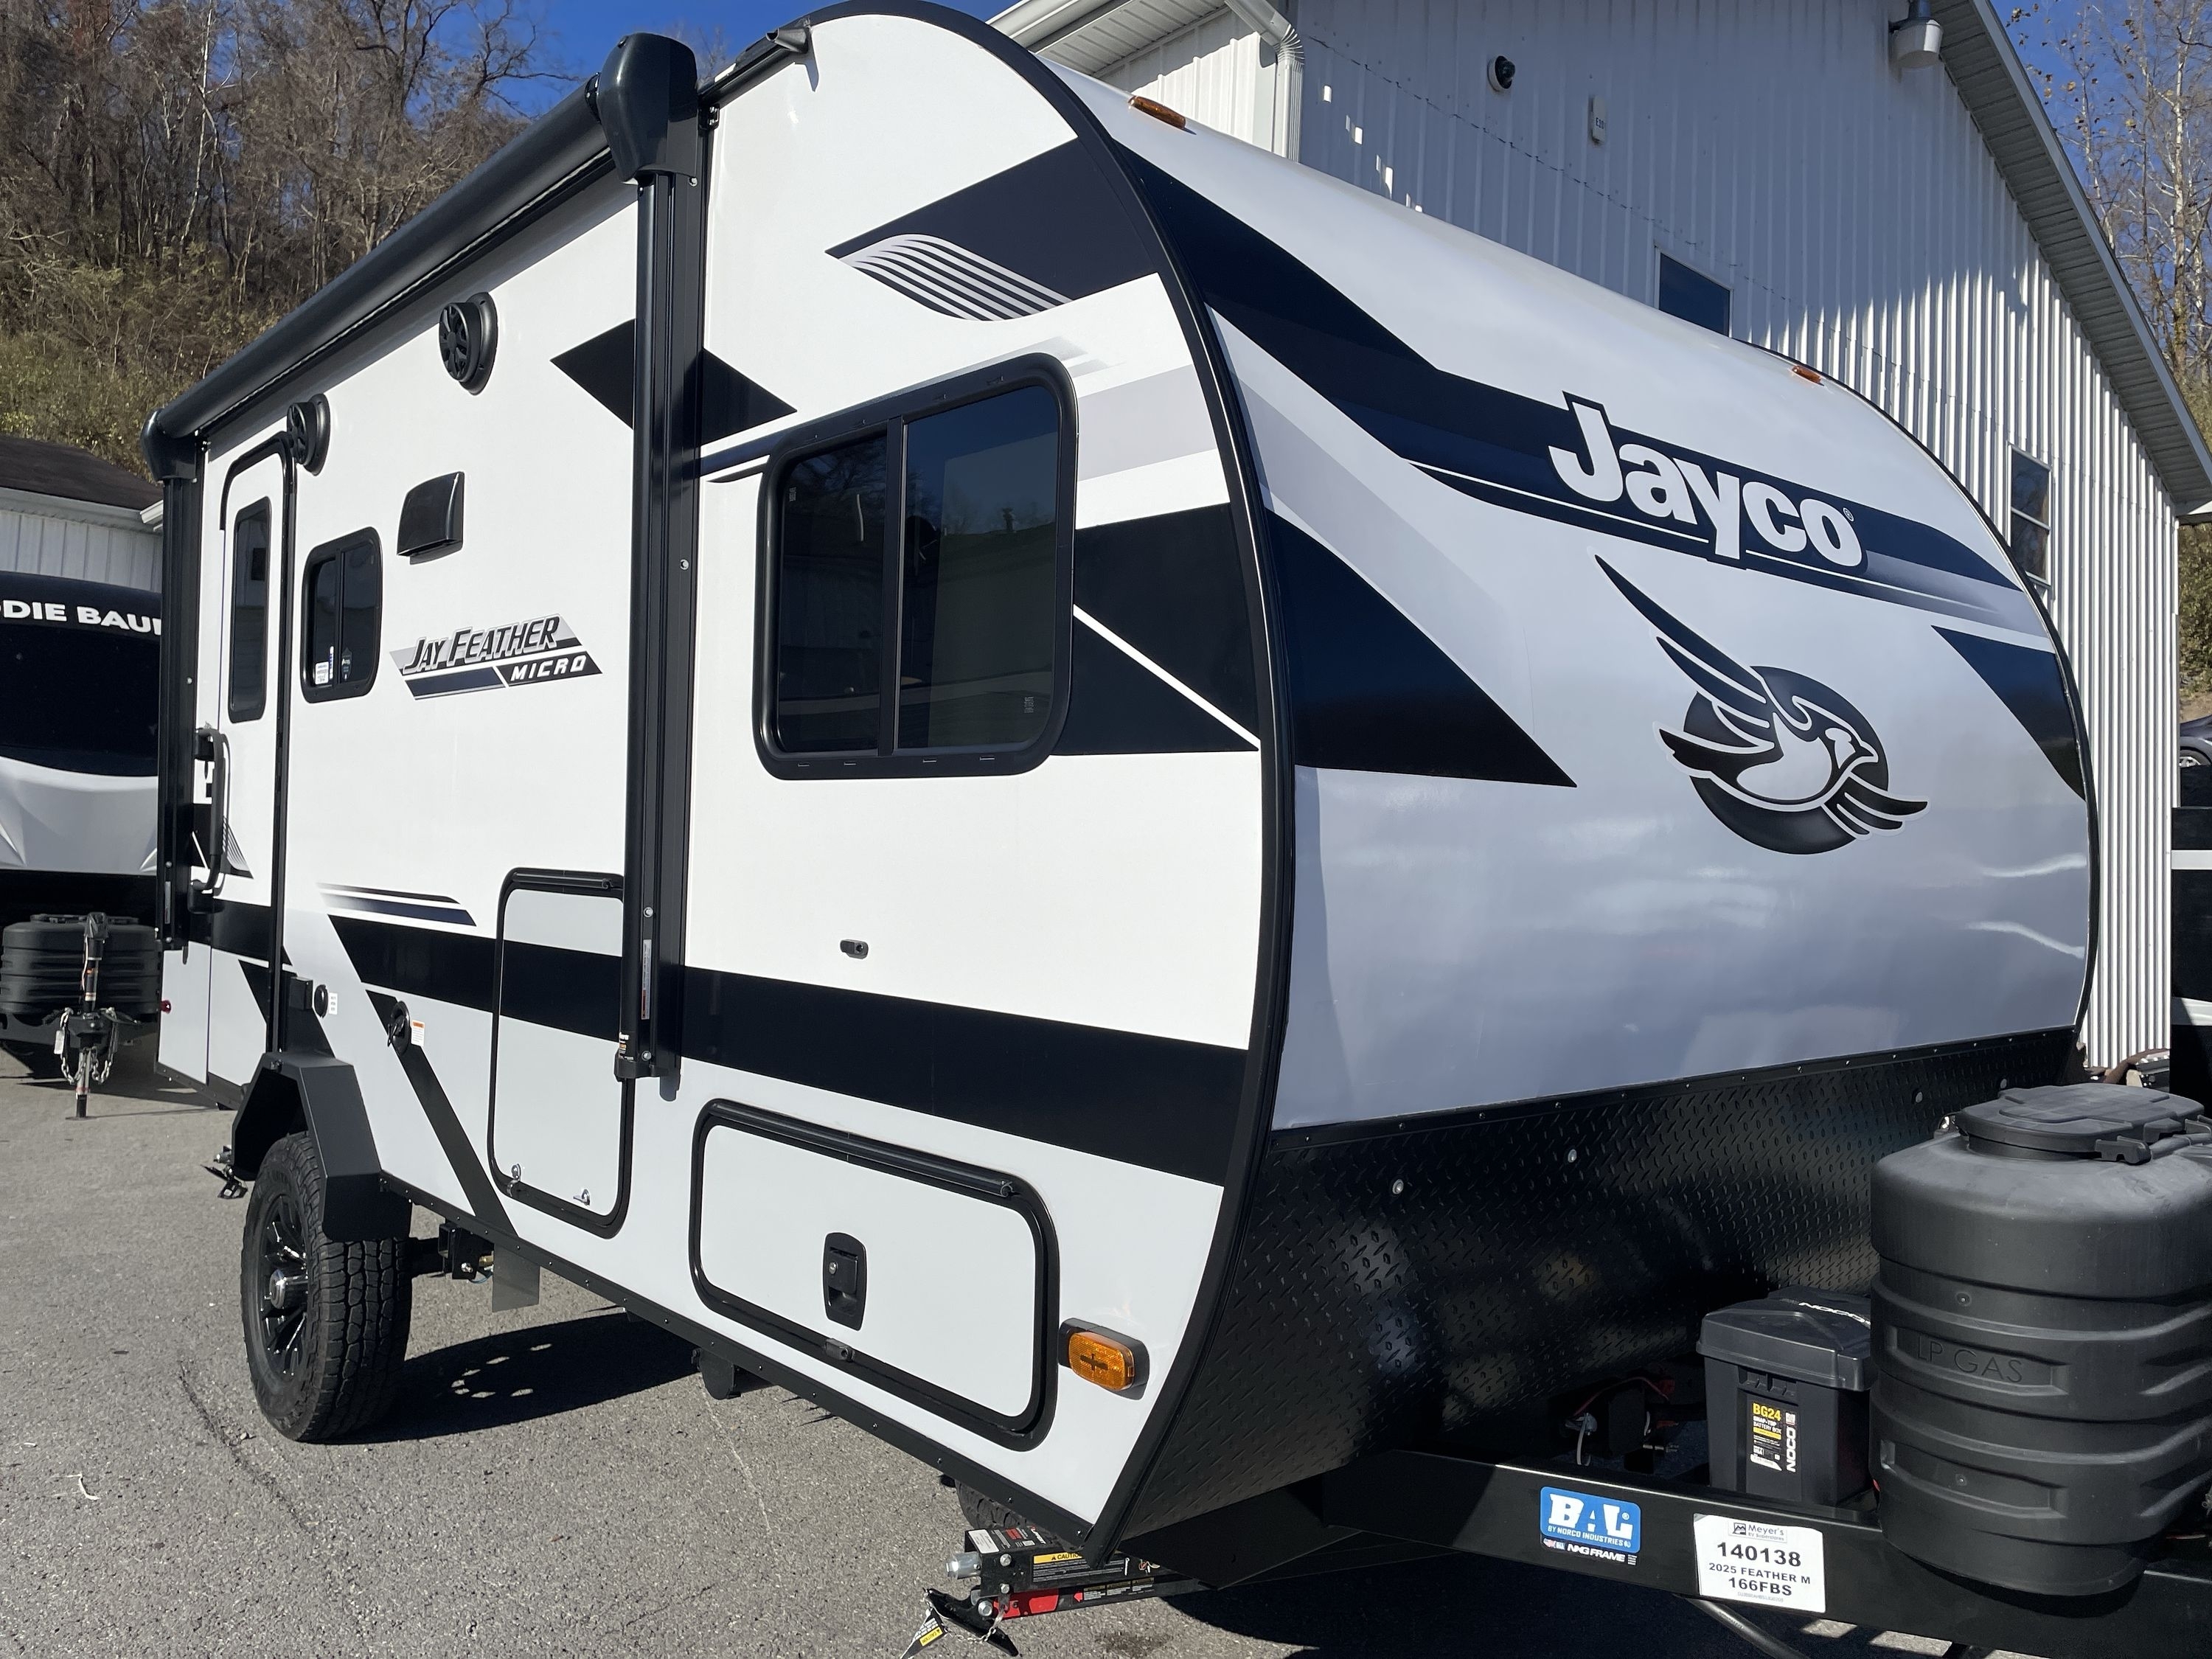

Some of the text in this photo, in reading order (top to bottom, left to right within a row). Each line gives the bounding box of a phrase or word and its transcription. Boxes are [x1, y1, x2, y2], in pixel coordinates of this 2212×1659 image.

[1548, 401, 1863, 568] Jayco
[0, 599, 68, 622] DIE
[403, 638, 448, 674] JAY
[447, 614, 560, 666] FEATHER
[509, 654, 588, 682] MICRO
[1918, 1335, 2023, 1383] LP GAS
[1753, 1402, 1781, 1422] BG24
[1753, 1421, 1772, 1432] BATTERY
[1786, 1425, 1796, 1472] NOCO
[1548, 1493, 1633, 1540] BAL
[1557, 1528, 1582, 1538] NORCO
[1582, 1532, 1624, 1546] INDUSTRIES
[1748, 1524, 1784, 1536] Meyer's
[1717, 1542, 1801, 1567] 140138
[1708, 1562, 1811, 1585] 2025 FEATHER M
[1728, 1577, 1792, 1596] 166FBS
